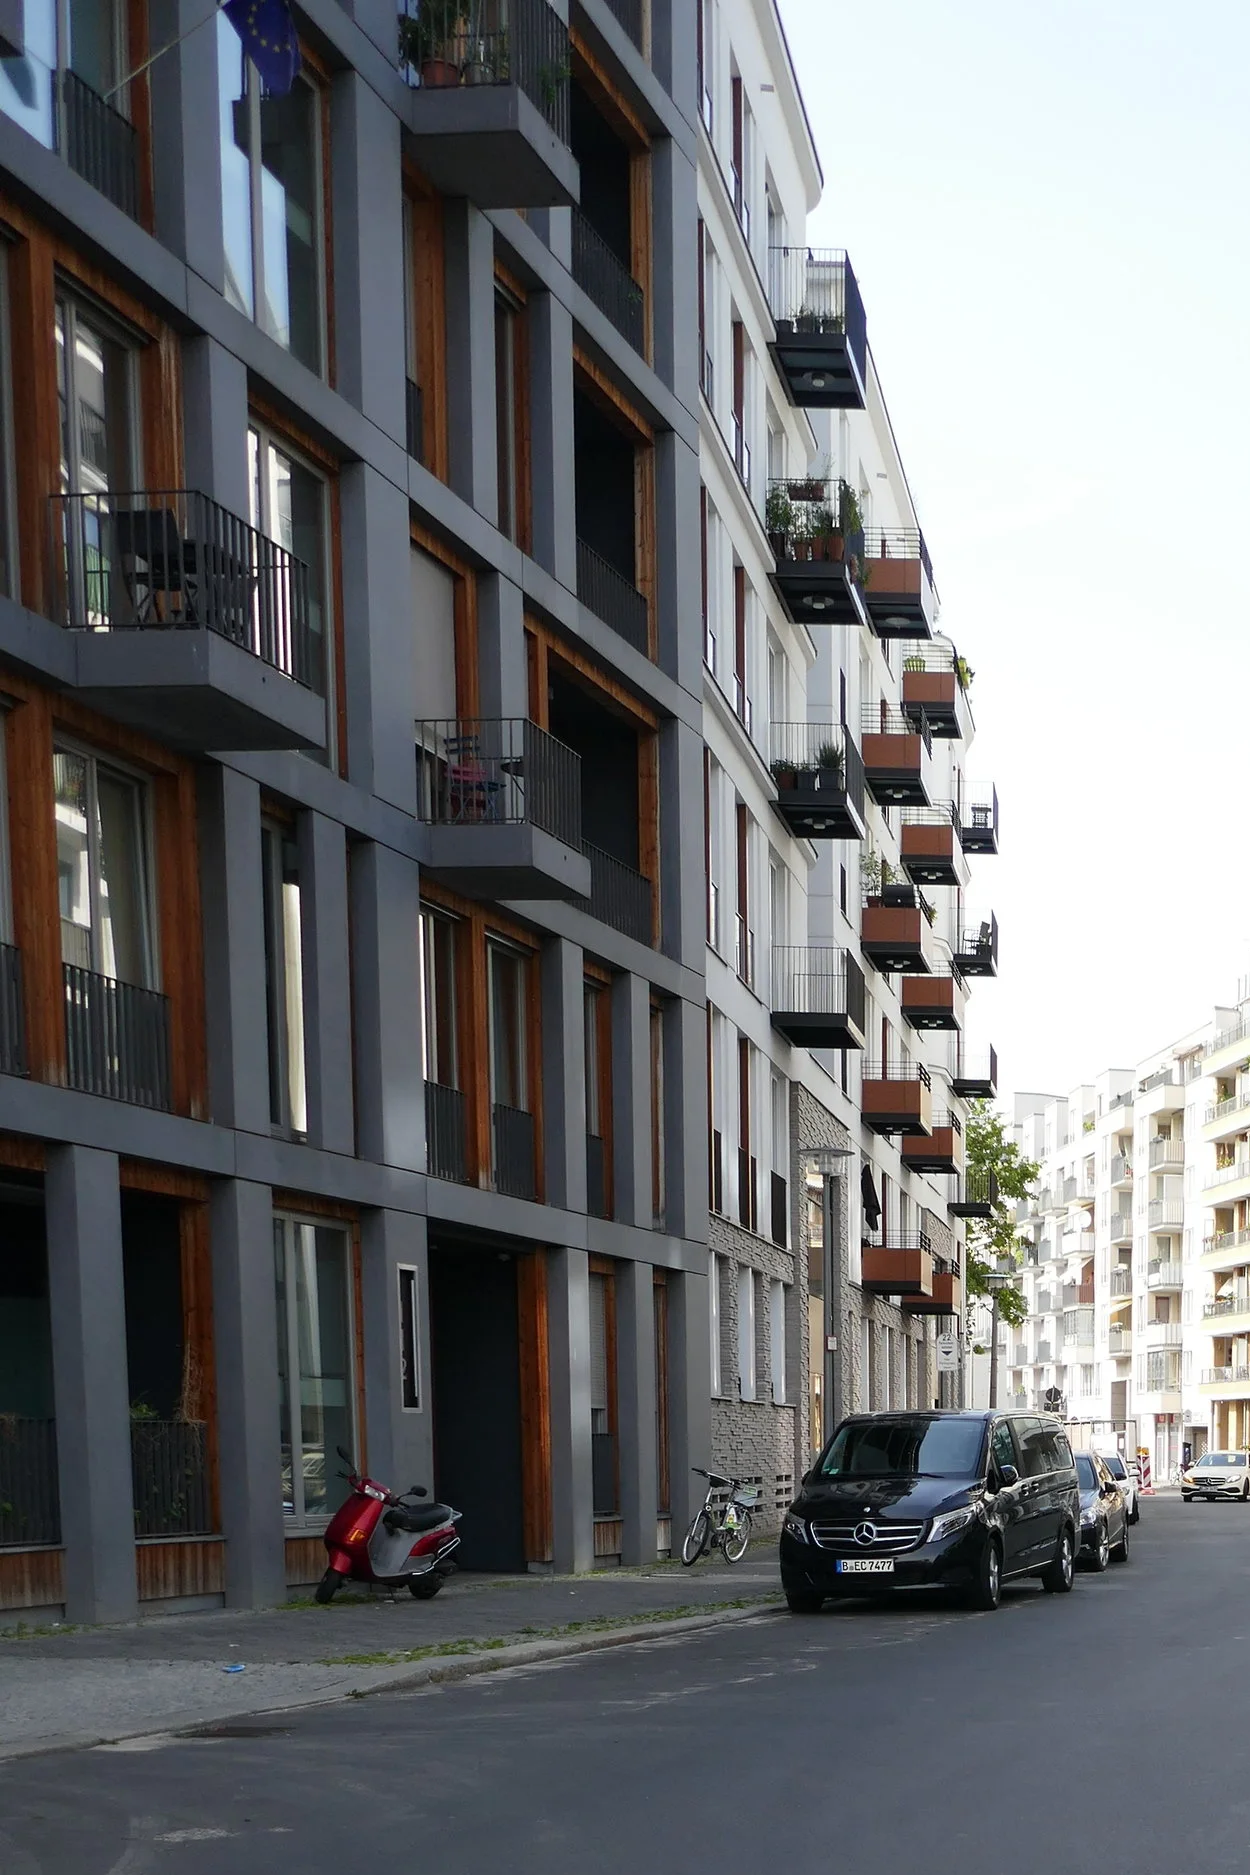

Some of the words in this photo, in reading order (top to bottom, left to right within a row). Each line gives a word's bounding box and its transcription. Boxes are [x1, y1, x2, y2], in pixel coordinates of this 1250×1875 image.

[842, 1561, 849, 1571] B
[854, 1561, 867, 1571] EC
[868, 1561, 892, 1571] 7477
